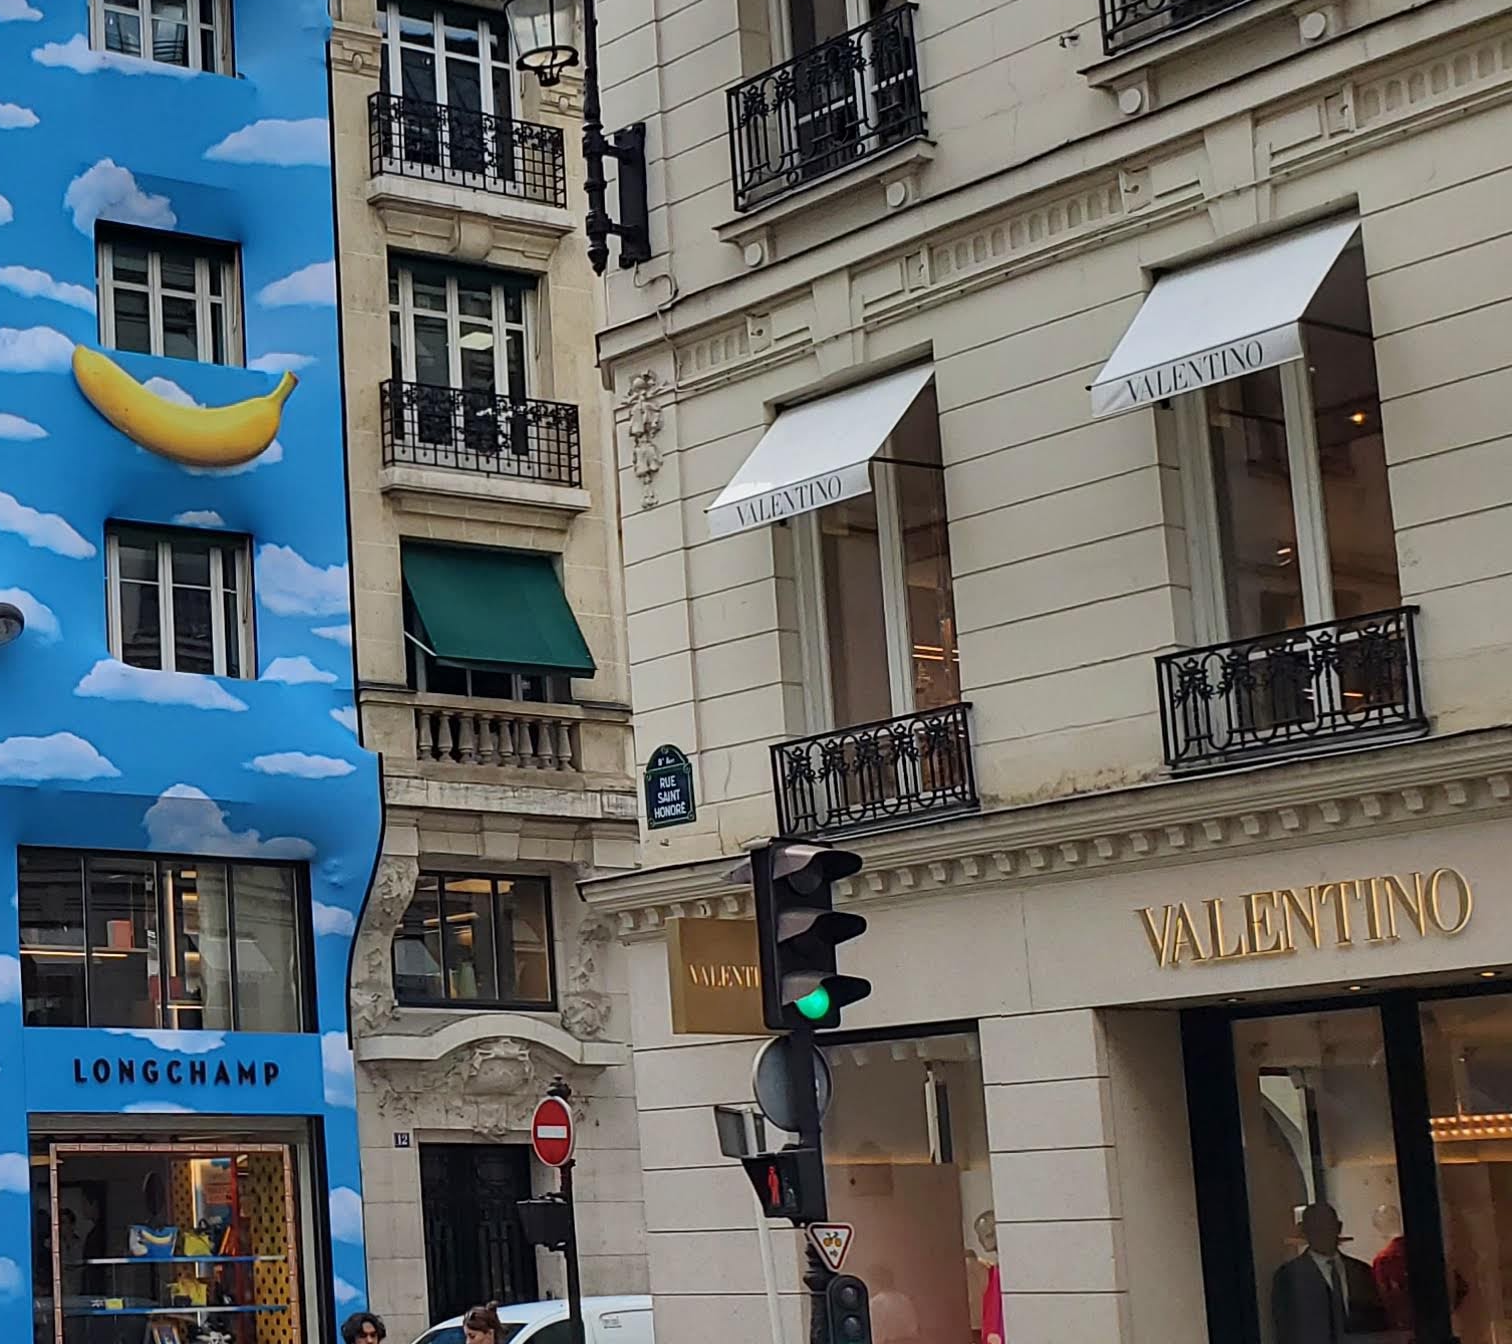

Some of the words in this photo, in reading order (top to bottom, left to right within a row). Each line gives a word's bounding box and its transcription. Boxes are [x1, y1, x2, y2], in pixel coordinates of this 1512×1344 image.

[1126, 339, 1264, 403] VALENTINO
[736, 475, 842, 526] VALENTINO
[659, 775, 677, 789] RUE
[657, 789, 681, 804] SAINT
[653, 801, 687, 819] HONORÉ
[1133, 867, 1473, 969] VALENTINO
[689, 964, 759, 988] VALENTI
[72, 1057, 280, 1087] LONGCHAMP
[397, 1133, 408, 1146] 12
